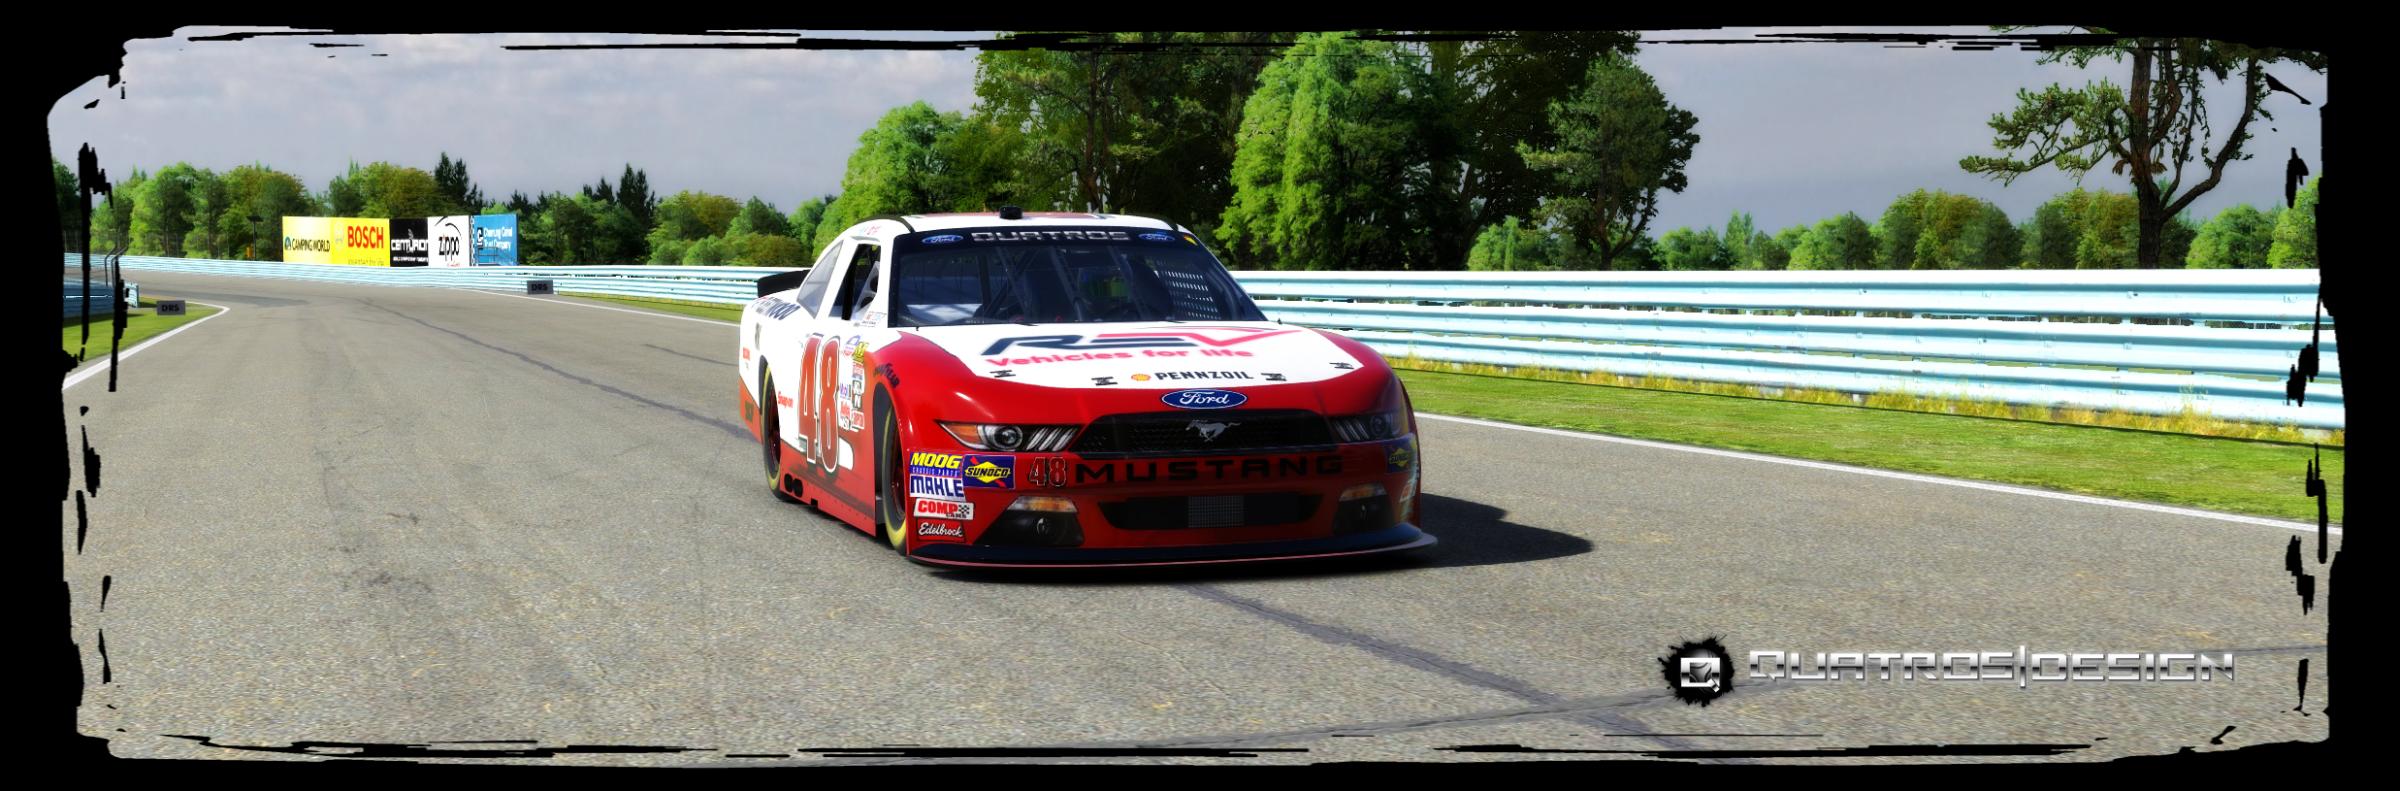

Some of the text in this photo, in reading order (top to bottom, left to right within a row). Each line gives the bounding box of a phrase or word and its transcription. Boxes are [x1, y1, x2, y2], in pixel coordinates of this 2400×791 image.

[347, 225, 384, 249] BOSCH
[971, 230, 1131, 243] QUATROS
[292, 238, 331, 252] CAMPING WORLD
[438, 234, 461, 261] zippo
[531, 283, 548, 291] DRS
[161, 304, 180, 313] DRS
[981, 330, 1304, 356] REV
[986, 347, 1254, 367] Vehicles for life
[1155, 370, 1254, 381] PENNZOIL
[798, 333, 841, 473] 48
[1179, 389, 1231, 406] Ford
[911, 453, 963, 469] MOOG
[965, 467, 1011, 478] SUNOCO
[1028, 456, 1067, 487] 48
[1075, 455, 1343, 484] MUSTANG
[911, 476, 964, 498] MAHLE
[918, 500, 959, 515] COMP
[918, 522, 963, 537] Edelbrock
